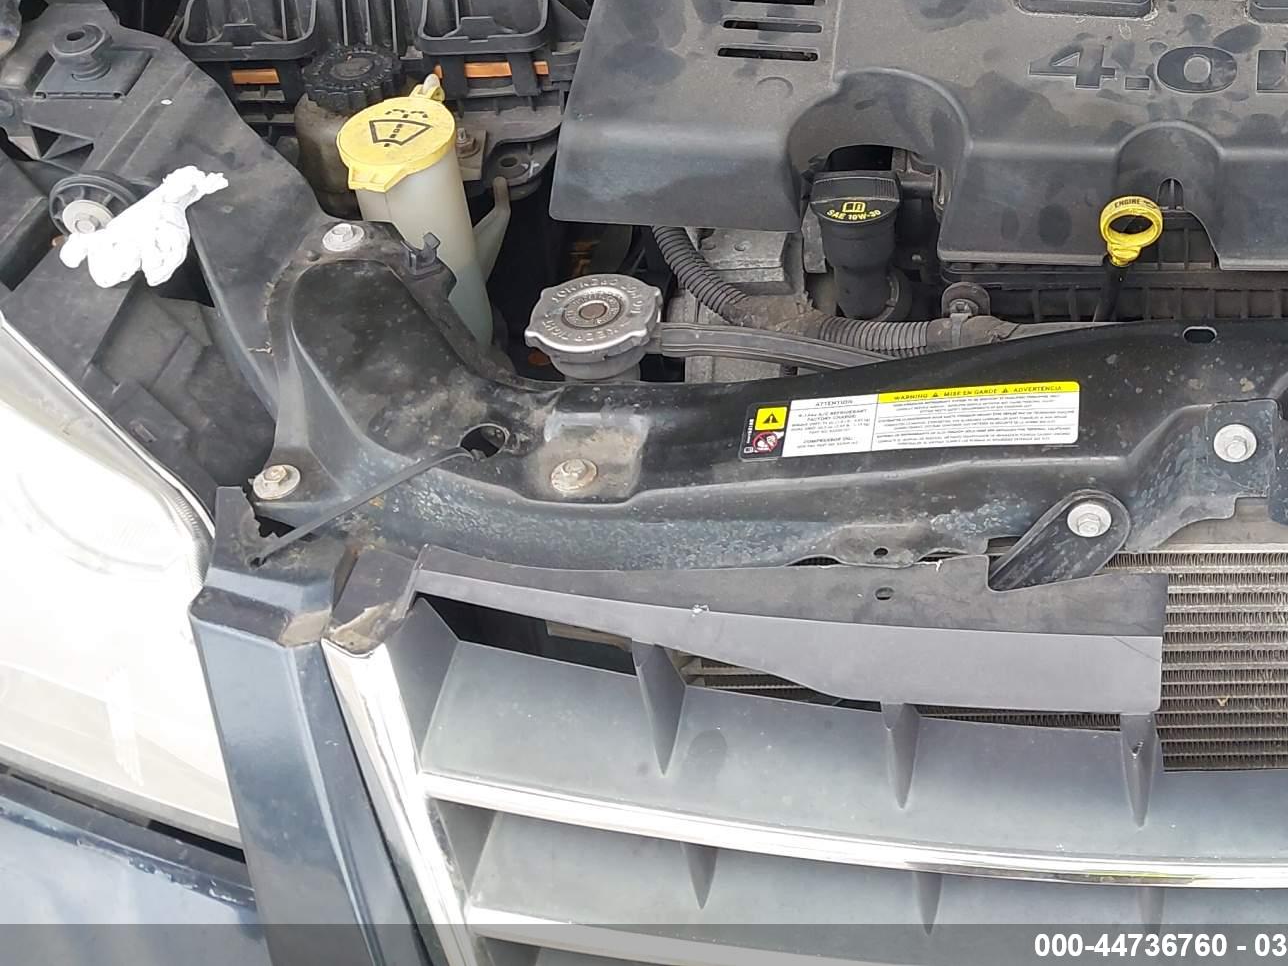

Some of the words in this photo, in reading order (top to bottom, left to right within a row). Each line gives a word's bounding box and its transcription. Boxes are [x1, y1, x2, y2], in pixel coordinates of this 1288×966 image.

[1114, 199, 1140, 208] ENGINE
[826, 210, 846, 219] SAE
[848, 210, 881, 221] 10W-30
